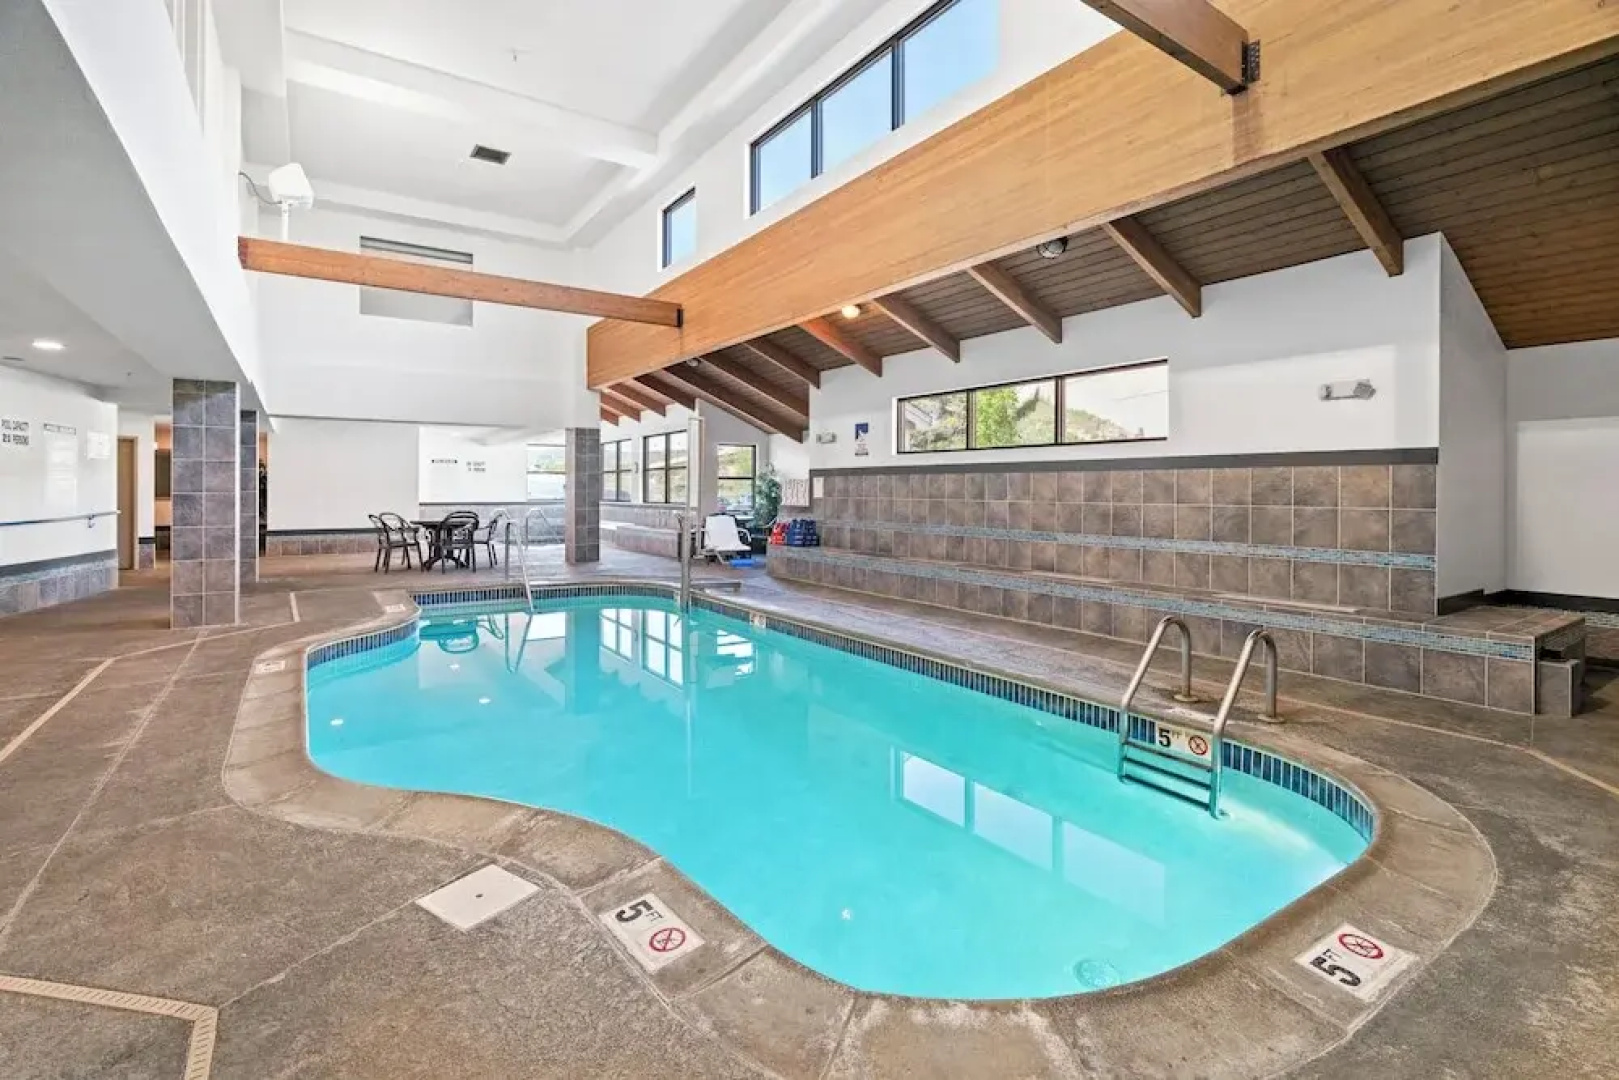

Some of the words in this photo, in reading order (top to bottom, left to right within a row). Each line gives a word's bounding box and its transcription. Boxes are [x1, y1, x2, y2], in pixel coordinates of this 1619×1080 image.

[1158, 727, 1171, 748] 5
[615, 900, 653, 922] 5
[645, 910, 663, 922] FT
[1322, 948, 1342, 962] FT
[1309, 956, 1361, 986] 5
